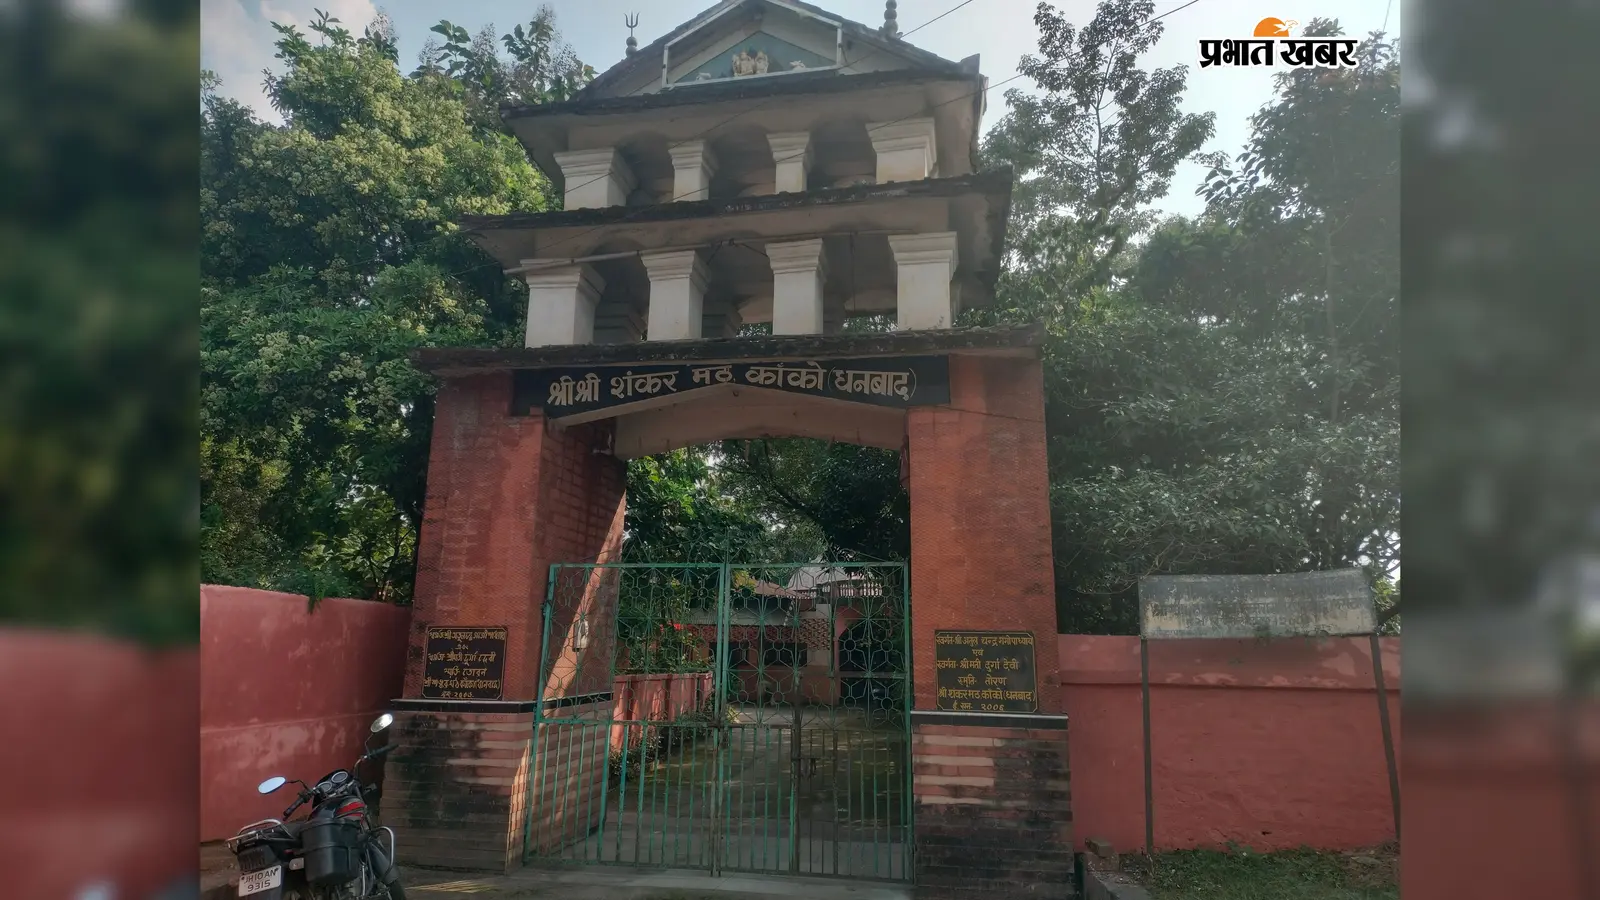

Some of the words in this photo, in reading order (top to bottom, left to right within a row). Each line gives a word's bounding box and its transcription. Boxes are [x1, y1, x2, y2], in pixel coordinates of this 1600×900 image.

[610, 370, 679, 399] शंकर
[692, 365, 733, 385] मठ
[247, 880, 271, 892] 9315
